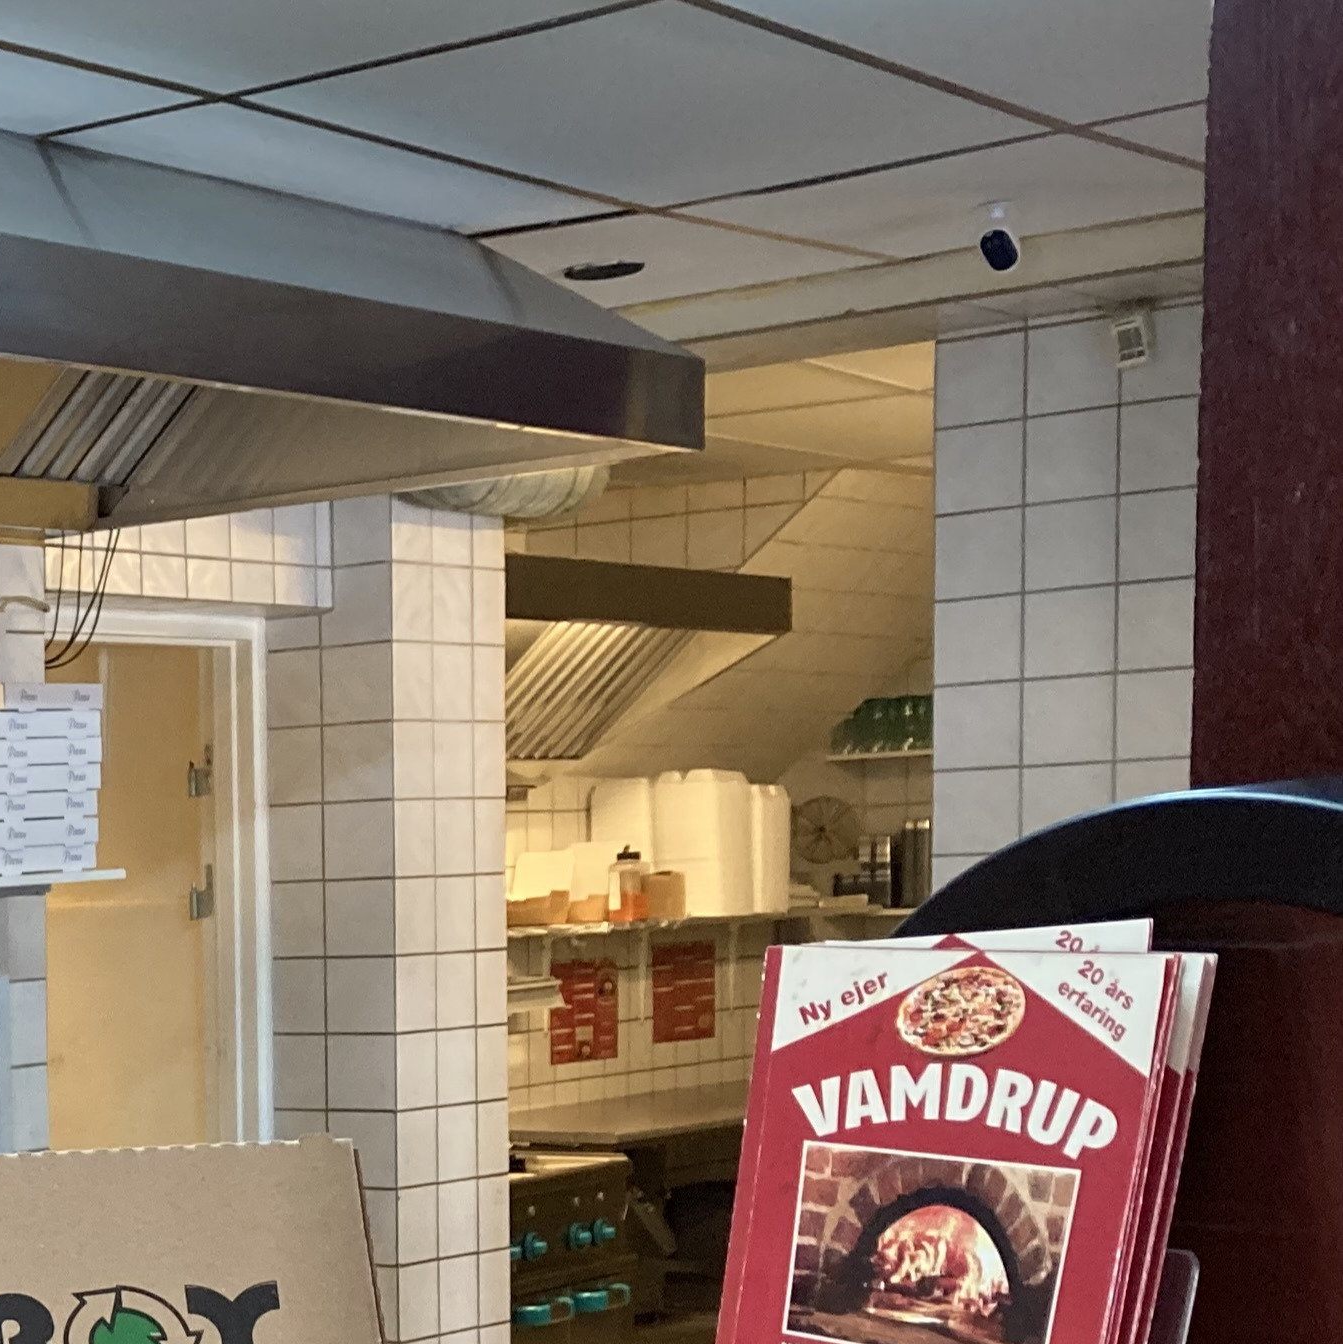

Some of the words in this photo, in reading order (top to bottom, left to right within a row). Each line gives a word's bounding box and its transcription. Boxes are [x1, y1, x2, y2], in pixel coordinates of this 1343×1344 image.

[1055, 930, 1083, 952] 20
[799, 1002, 832, 1027] Ny
[841, 971, 889, 1007] ejer
[1057, 982, 1127, 1043] erfaring
[1077, 960, 1105, 986] 20
[1103, 978, 1135, 1012] års
[791, 1062, 1118, 1161] VAMDRUP
